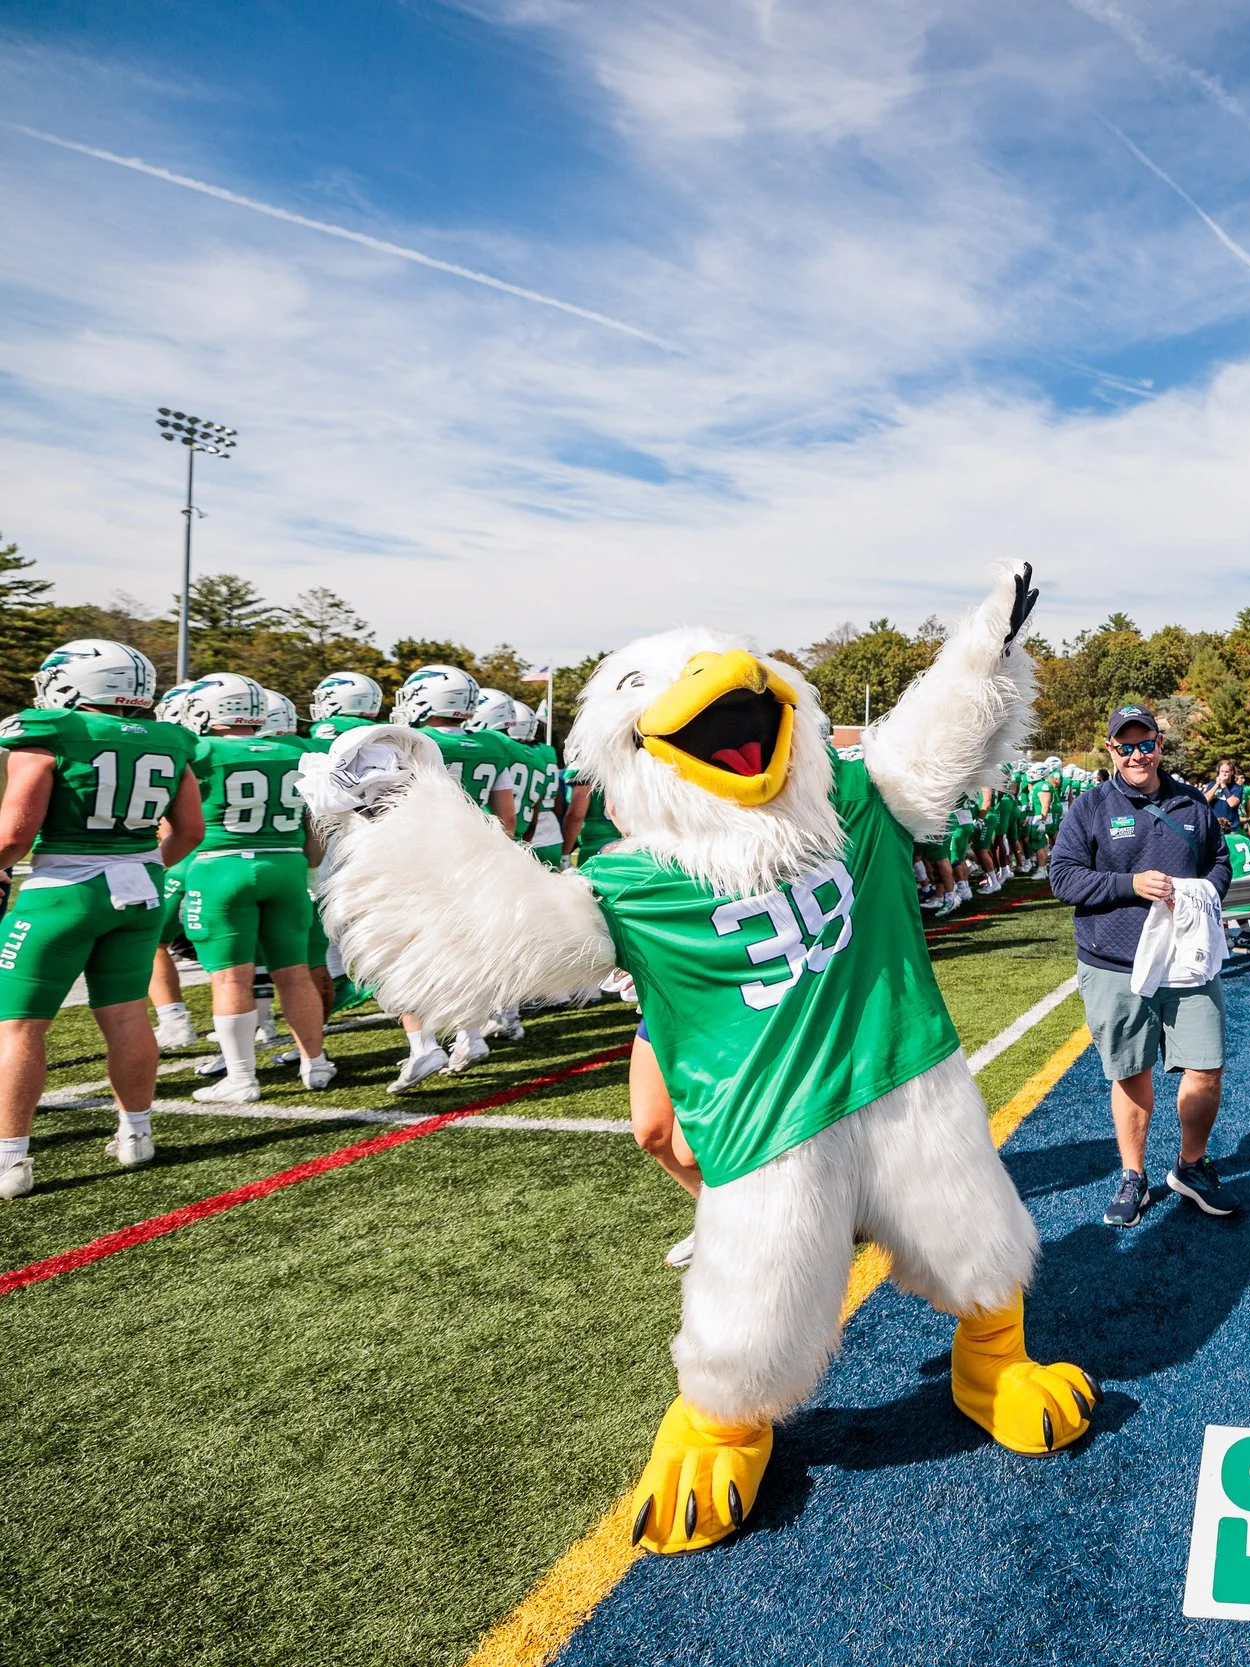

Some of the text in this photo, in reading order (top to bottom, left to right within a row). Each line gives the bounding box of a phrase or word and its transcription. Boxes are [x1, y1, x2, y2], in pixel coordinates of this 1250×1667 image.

[86, 750, 175, 830] 16
[222, 769, 306, 833] 89
[187, 890, 202, 930] GULLS
[709, 859, 855, 1012] 39
[0, 919, 32, 971] GULLS
